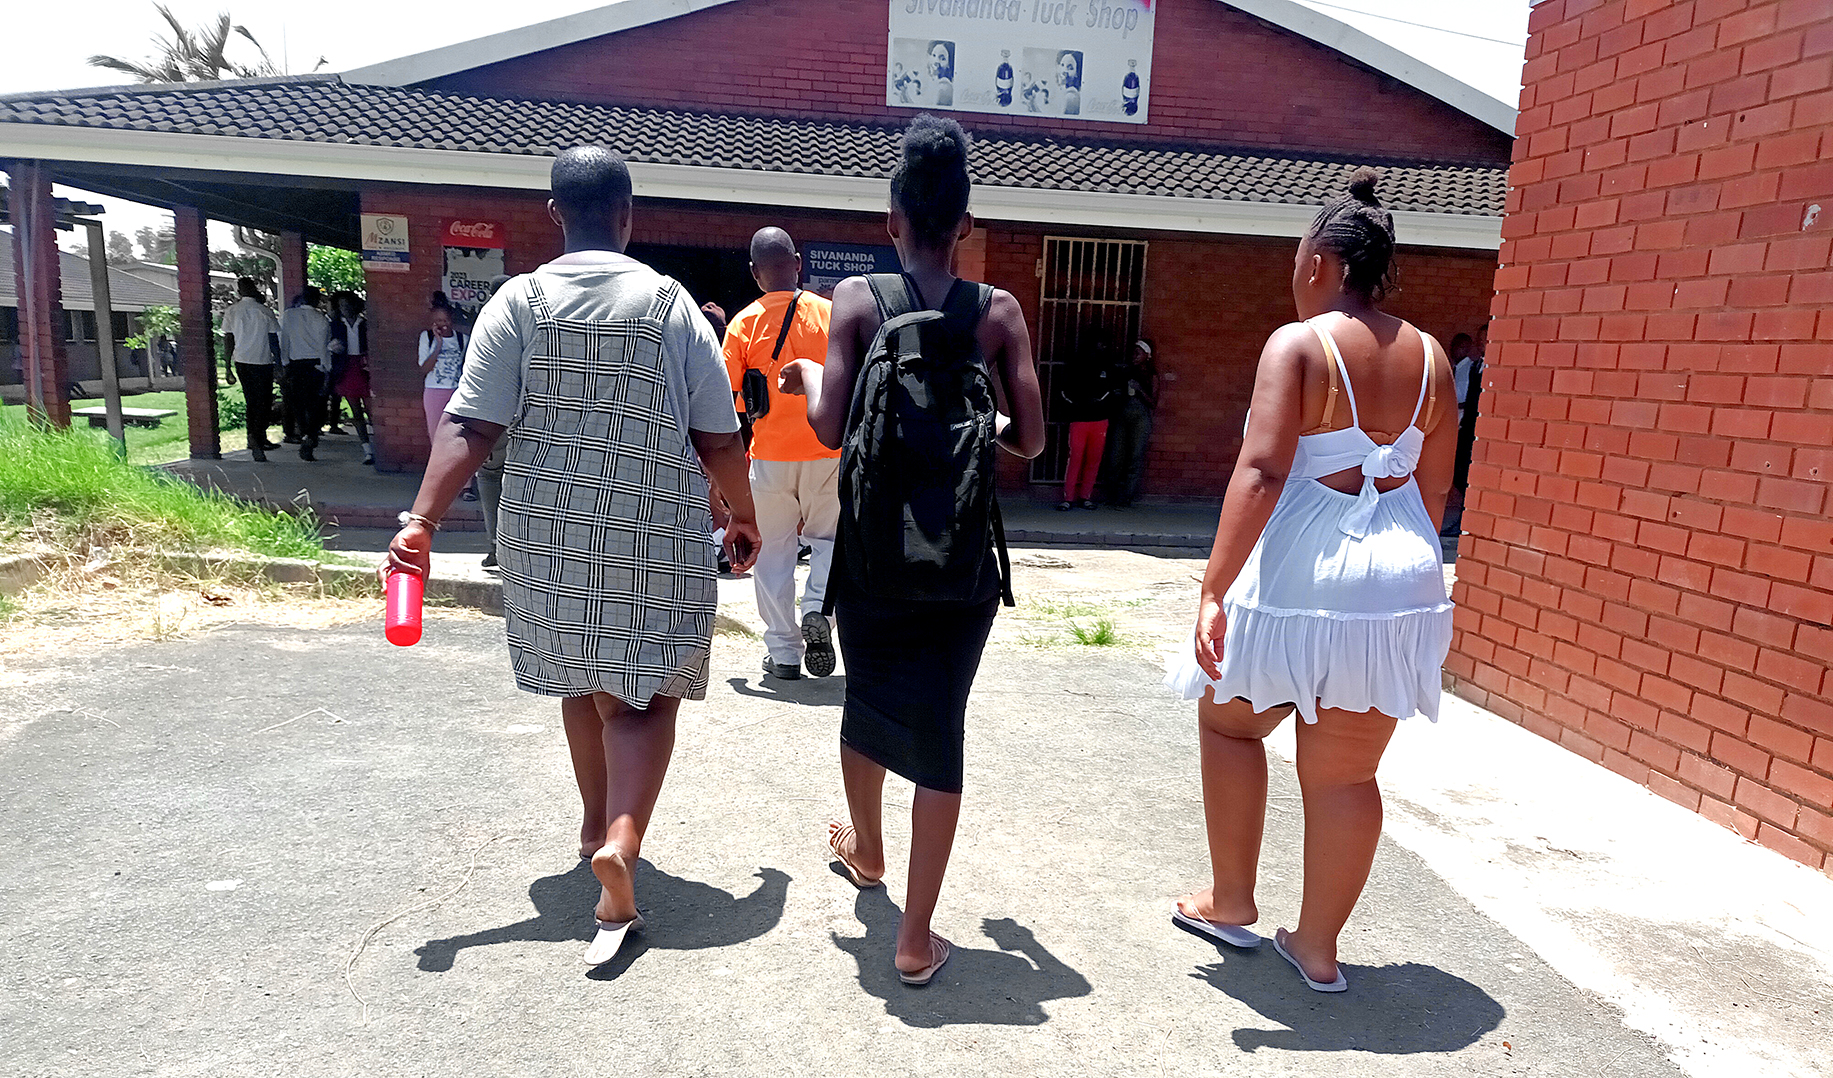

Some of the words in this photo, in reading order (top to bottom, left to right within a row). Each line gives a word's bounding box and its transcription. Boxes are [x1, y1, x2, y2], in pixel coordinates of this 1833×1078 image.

[1086, 0, 1139, 39] Shop
[449, 220, 495, 239] Coca-Cola
[365, 232, 406, 246] MZANSI
[810, 250, 876, 263] SIVANANDA
[810, 260, 841, 271] TUCK
[843, 262, 875, 272] SHOP
[449, 279, 492, 291] CAREER
[451, 288, 487, 302] EXPO
